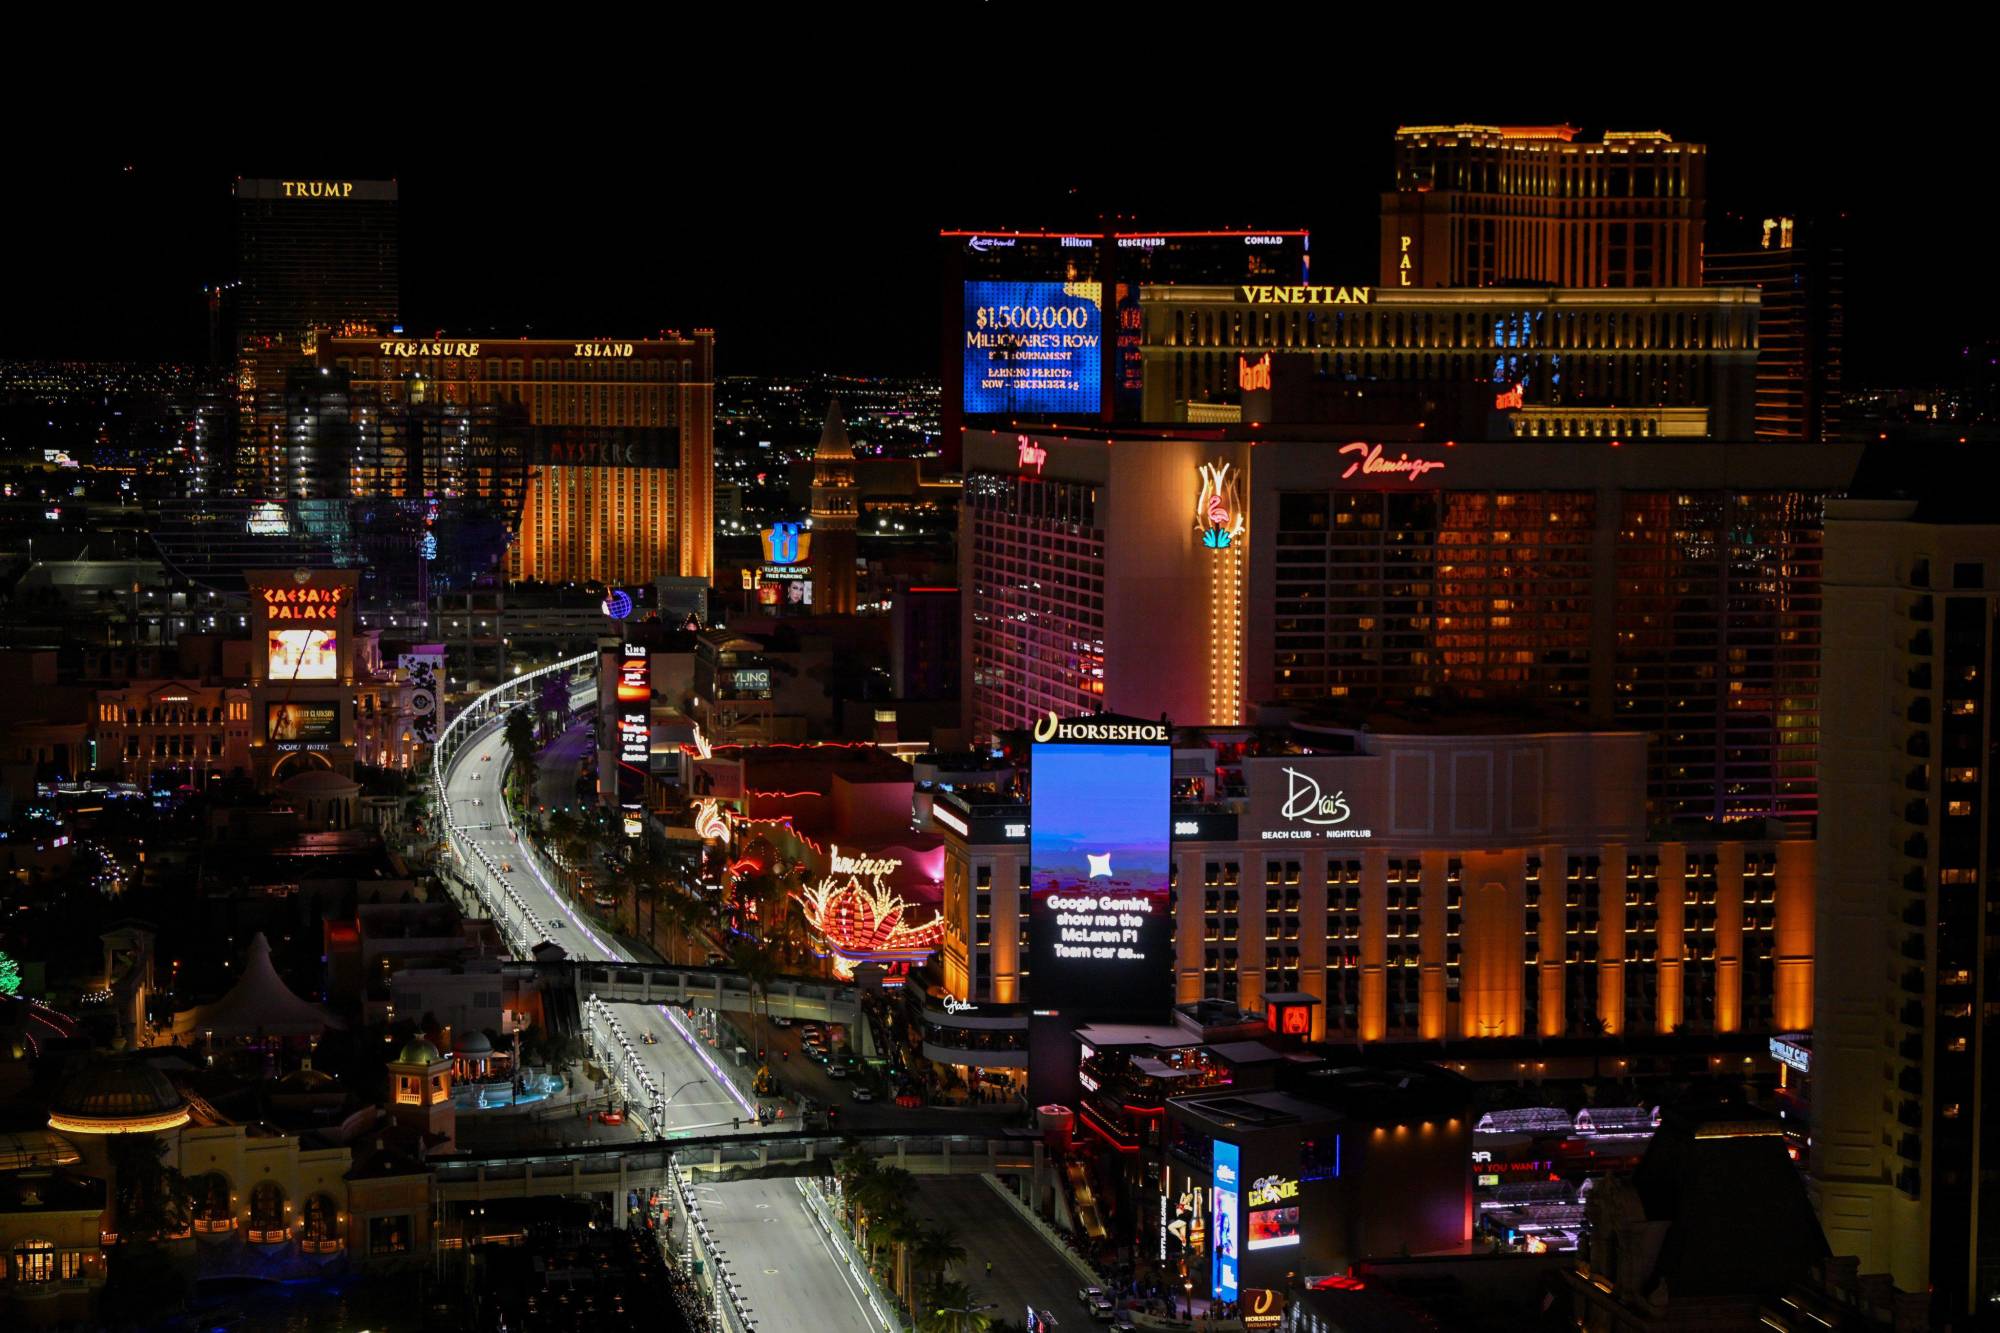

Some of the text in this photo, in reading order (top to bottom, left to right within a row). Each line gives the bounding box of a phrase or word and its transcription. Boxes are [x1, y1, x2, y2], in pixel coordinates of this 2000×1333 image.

[282, 182, 353, 197] TRUMP
[1061, 237, 1092, 247] Hilton
[1117, 238, 1166, 247] CROCKFORDS
[1244, 236, 1283, 245] CONRAD
[1242, 285, 1370, 304] VENETIAN
[976, 306, 1088, 330] $1,500,000
[1063, 334, 1099, 348] ROW
[380, 342, 633, 358] TREASURE ISLAND
[981, 379, 1003, 389] NOW
[1339, 442, 1445, 481] Flamingo
[263, 588, 342, 603] CAESARS
[268, 605, 337, 620] PALACE
[1059, 724, 1168, 740] HORSESHOE
[1281, 767, 1351, 825] Drai's
[1262, 829, 1371, 839] BEACH CLUB NIGHTCLUB
[1047, 895, 1152, 912] Google Gemini,
[1056, 912, 1143, 927] show me the
[1061, 928, 1138, 943] McLaren F1
[1054, 944, 1091, 958] Team
[1092, 947, 1116, 959] car
[1488, 1164, 1507, 1173] YOU
[1511, 1161, 1540, 1171] WANT
[1248, 1180, 1299, 1207] BLNDE
